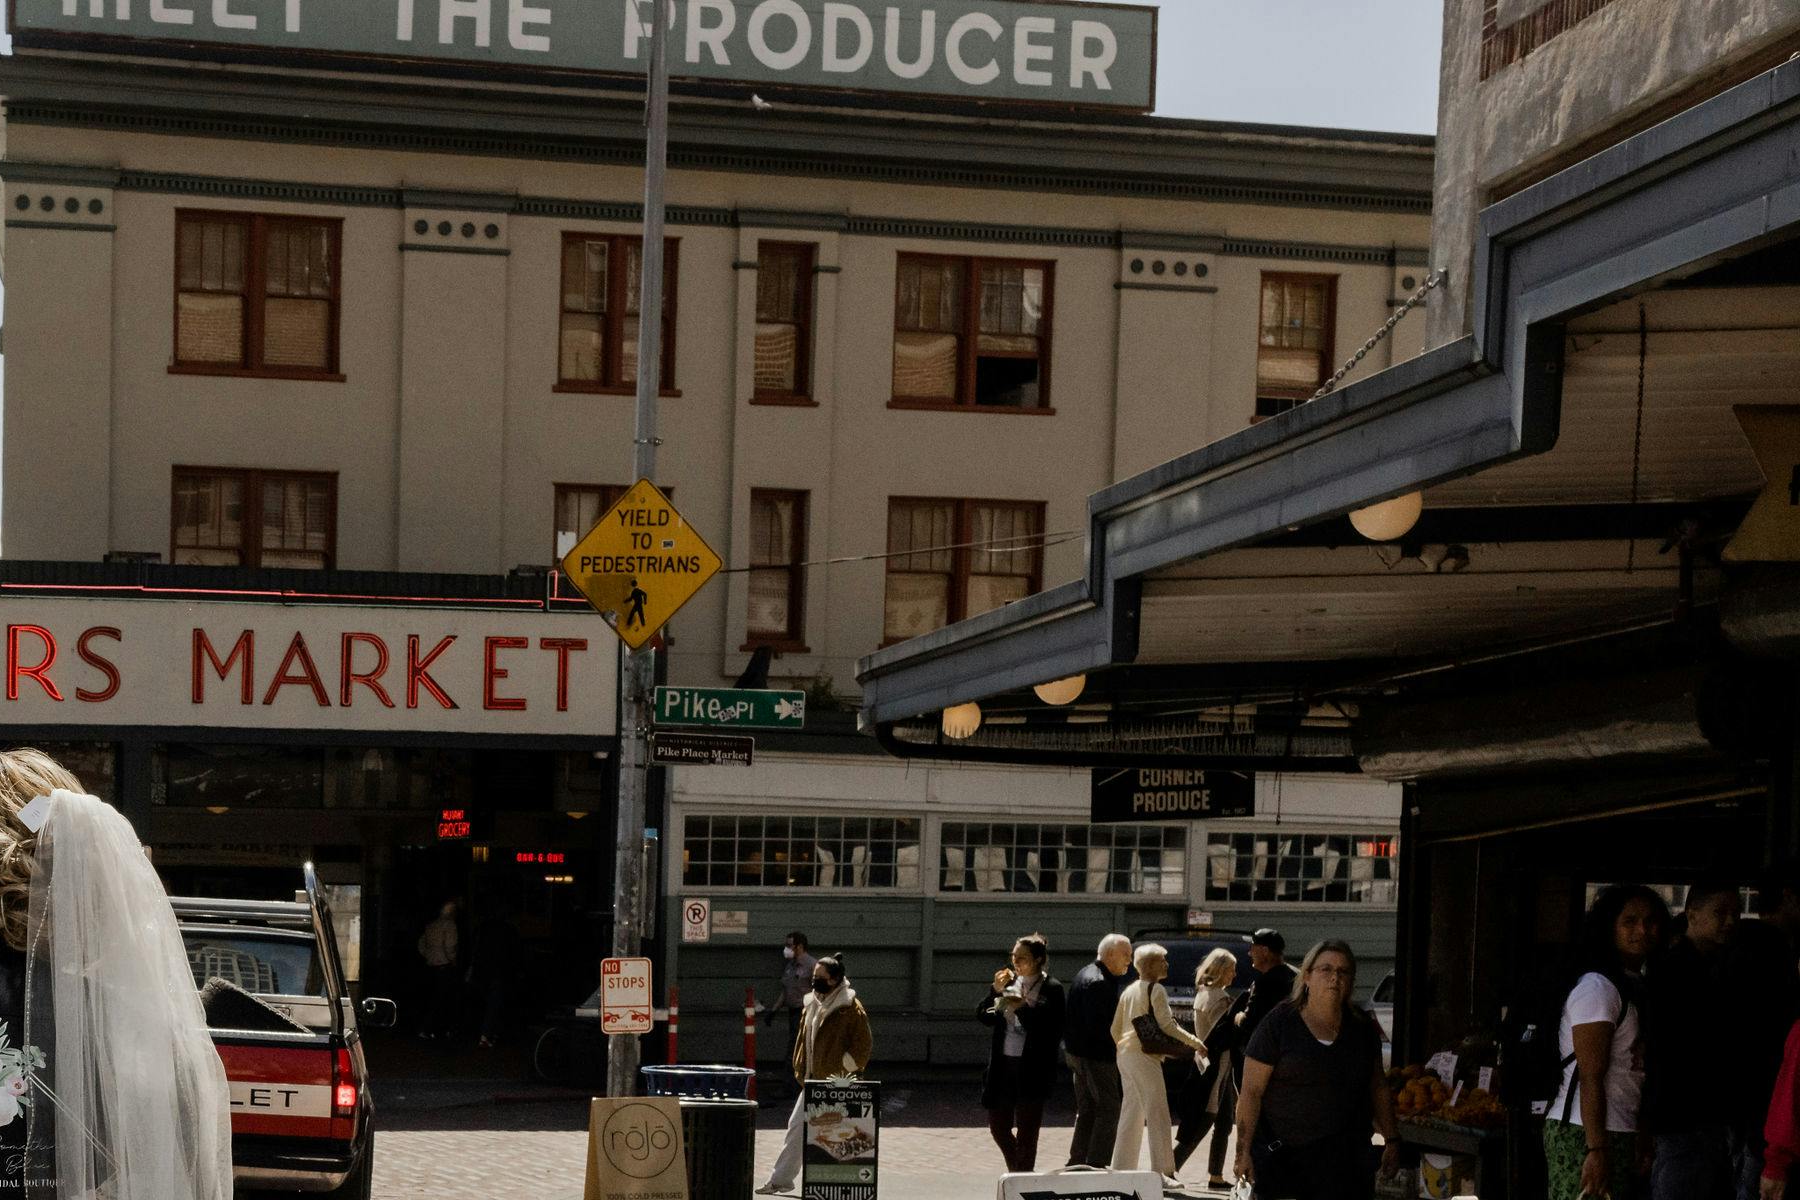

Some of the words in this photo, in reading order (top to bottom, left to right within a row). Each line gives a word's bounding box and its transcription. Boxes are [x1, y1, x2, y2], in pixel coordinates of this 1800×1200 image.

[622, 0, 1113, 90] PRODUCER
[617, 509, 669, 527] YIELD
[631, 532, 652, 550] TO
[580, 556, 700, 573] PEDESTRIANS
[192, 626, 588, 713] MARKET
[664, 690, 720, 719] Pike
[736, 701, 754, 720] Pl
[657, 746, 680, 757] Pike
[682, 748, 710, 758] Place
[712, 749, 749, 760] Market
[1138, 768, 1205, 788] CORNER
[1133, 789, 1211, 813] PRODUCE
[605, 962, 618, 972] NO
[608, 976, 645, 989] STOPS
[811, 1089, 827, 1099] los
[829, 1090, 873, 1102] agaves
[606, 1192, 626, 1200] 100%
[628, 1192, 650, 1200] COLD
[651, 1191, 683, 1200] PRESSED
